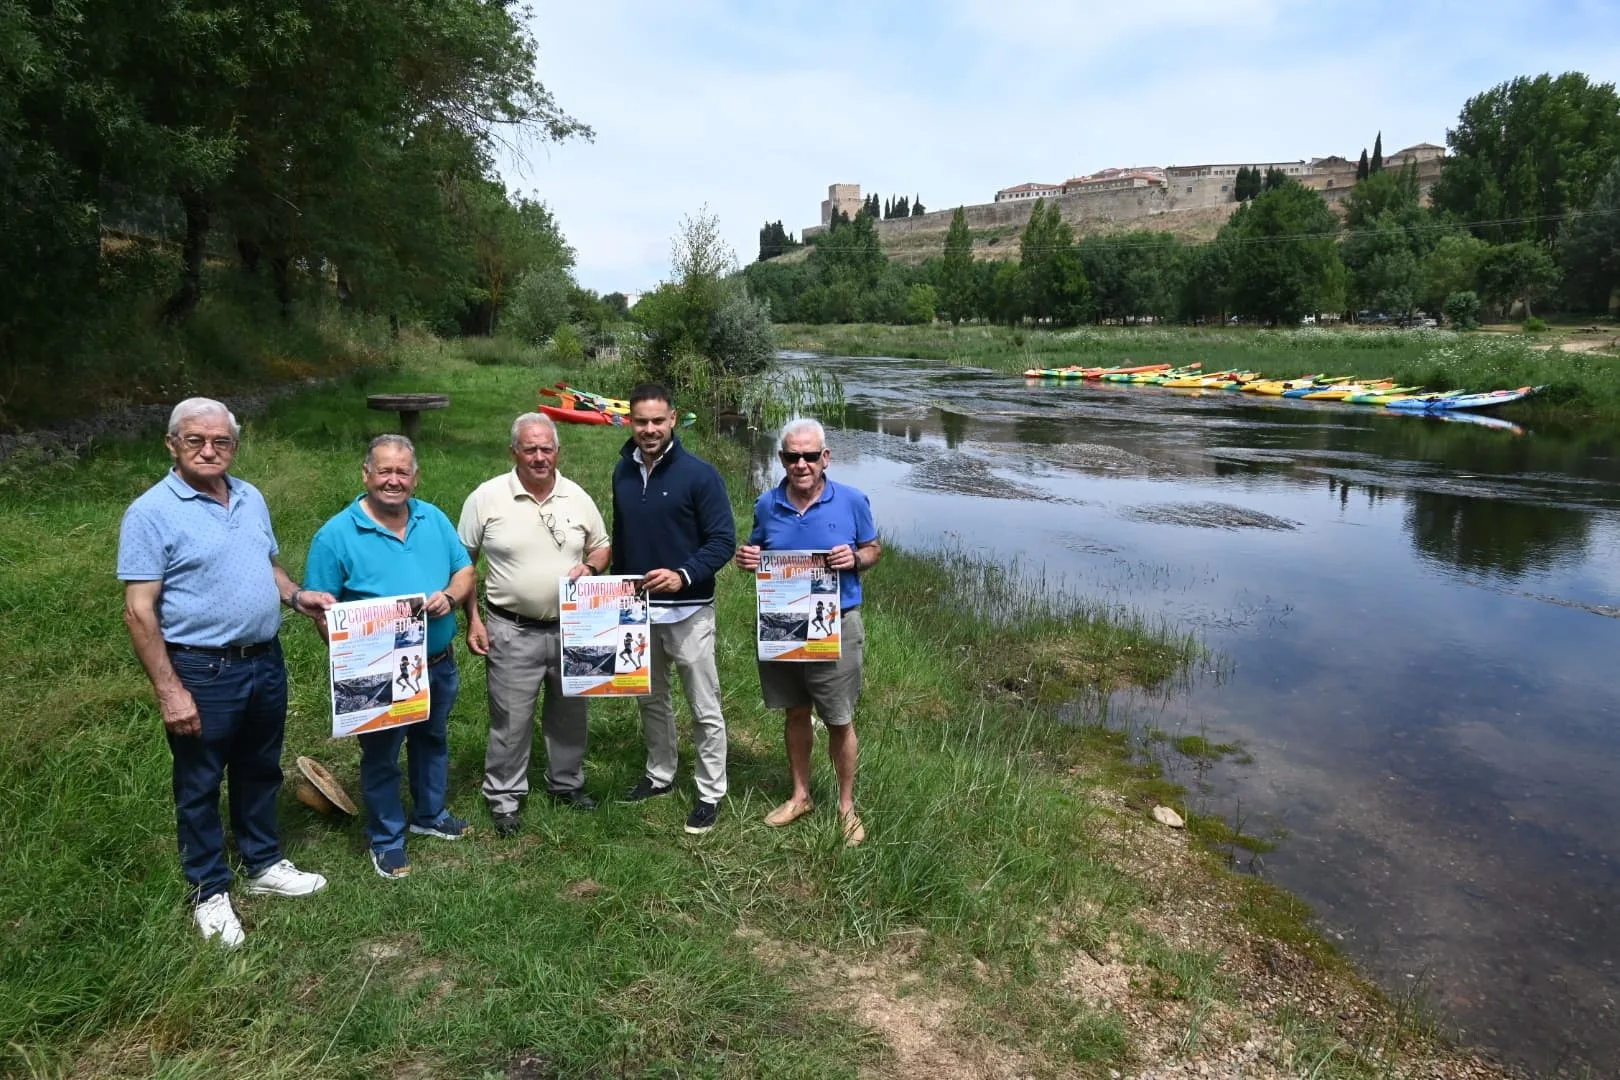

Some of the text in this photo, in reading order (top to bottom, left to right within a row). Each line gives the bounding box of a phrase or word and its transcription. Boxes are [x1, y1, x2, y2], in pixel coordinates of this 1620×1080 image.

[760, 555, 771, 572] 12
[565, 583, 577, 602] 12
[332, 609, 348, 631] 12
